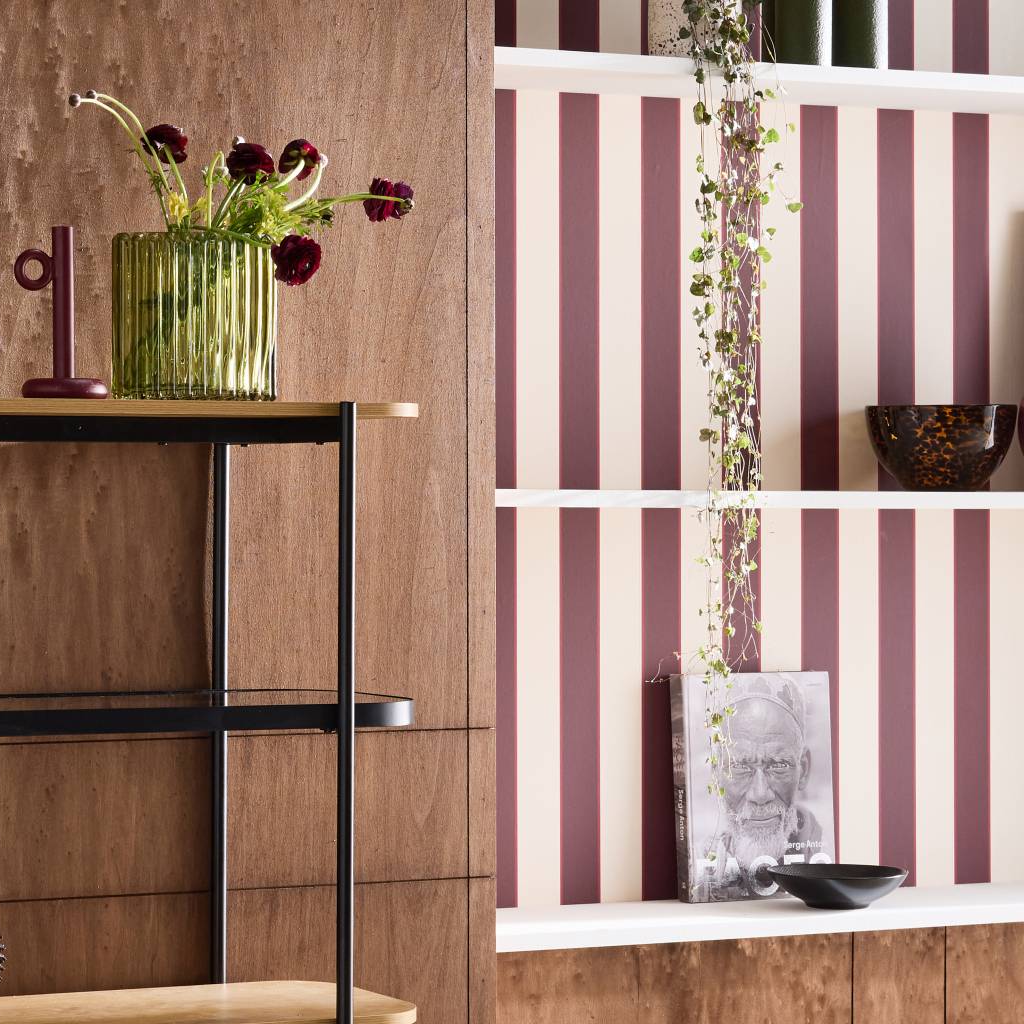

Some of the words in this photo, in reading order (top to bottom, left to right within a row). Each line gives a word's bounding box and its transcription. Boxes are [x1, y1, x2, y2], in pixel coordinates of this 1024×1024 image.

[783, 841, 804, 851] Serge
[806, 840, 825, 849] Anto
[696, 852, 833, 896] FAC
